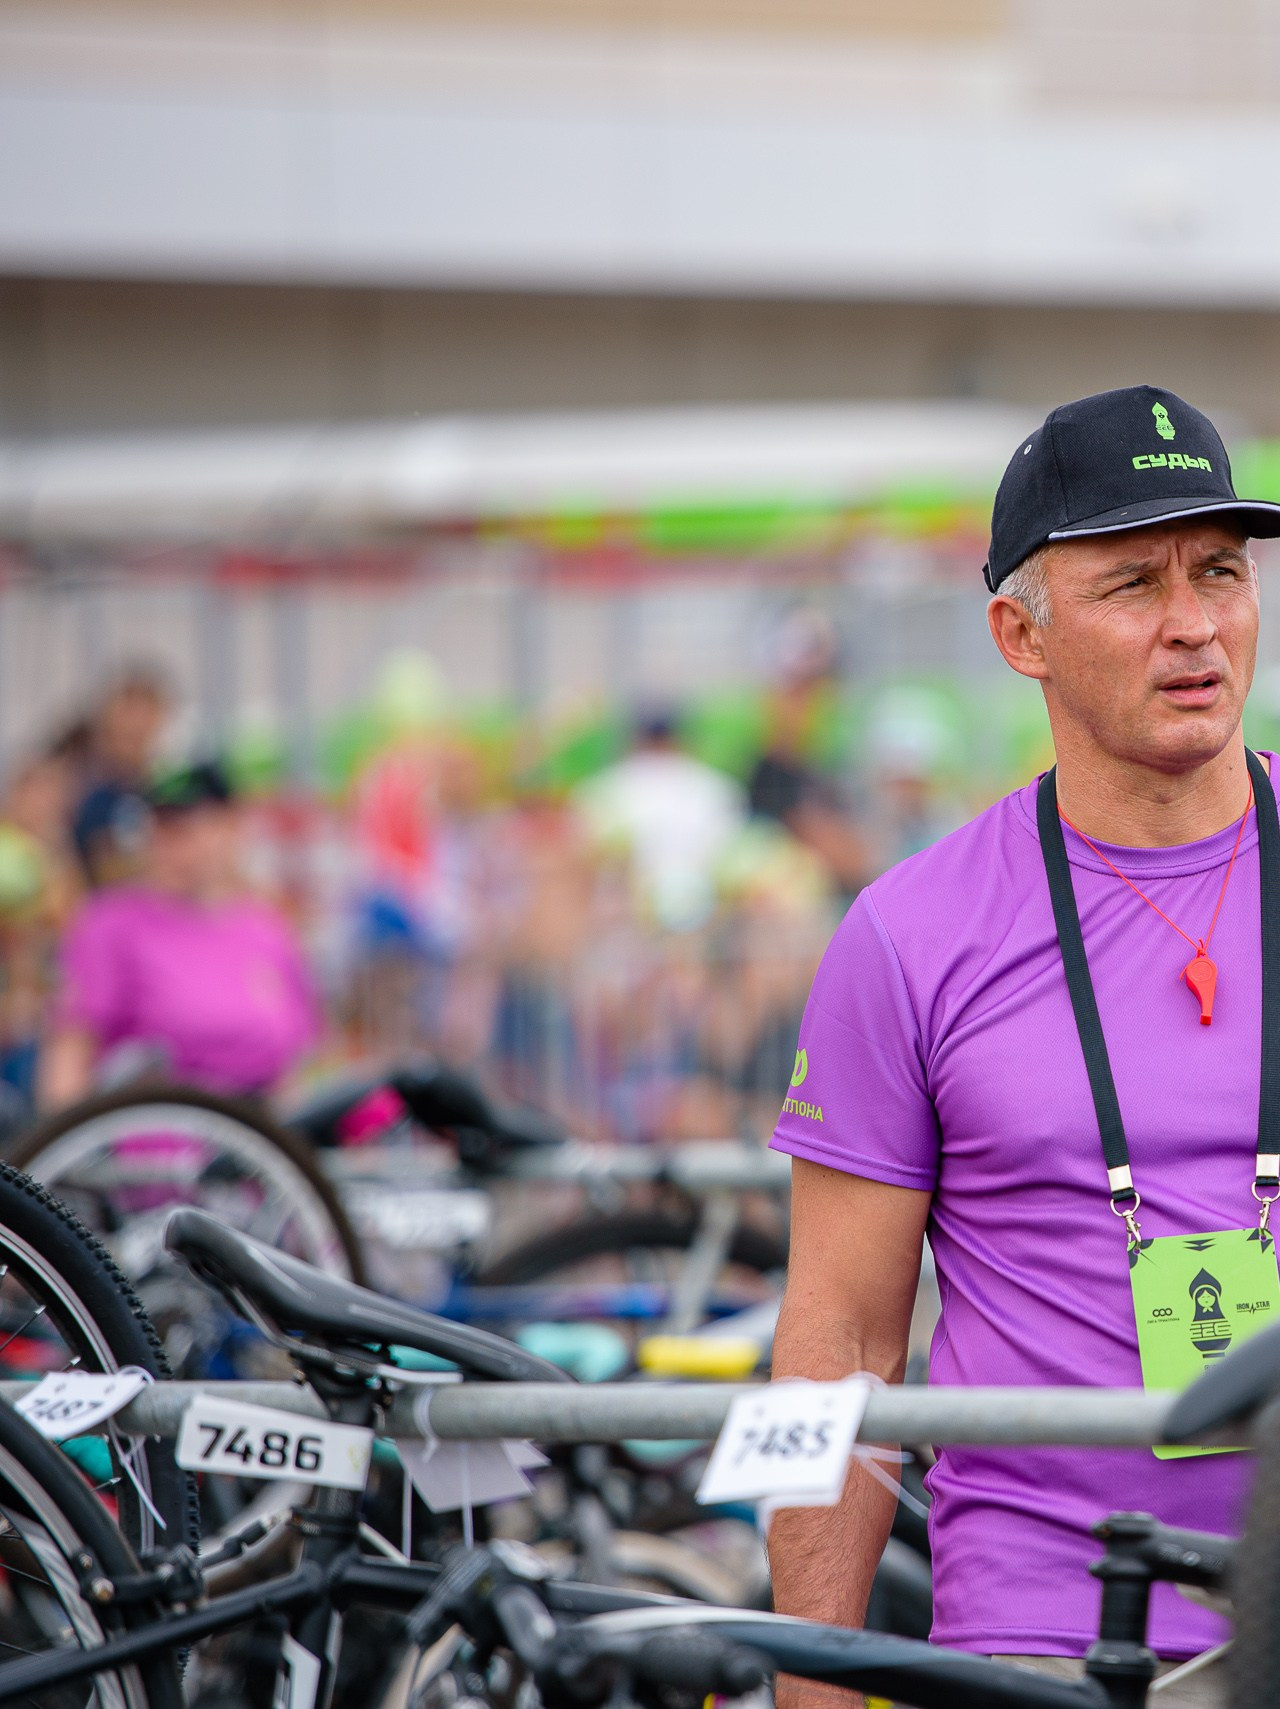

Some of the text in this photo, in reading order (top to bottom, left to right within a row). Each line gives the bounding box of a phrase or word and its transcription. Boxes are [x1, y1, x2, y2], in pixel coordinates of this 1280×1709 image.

[1132, 453, 1212, 473] СУДЬЯ
[1256, 1300, 1270, 1308] STAR
[26, 1399, 105, 1421] 7487
[199, 1423, 323, 1474] 7486
[732, 1419, 835, 1469] 7485
